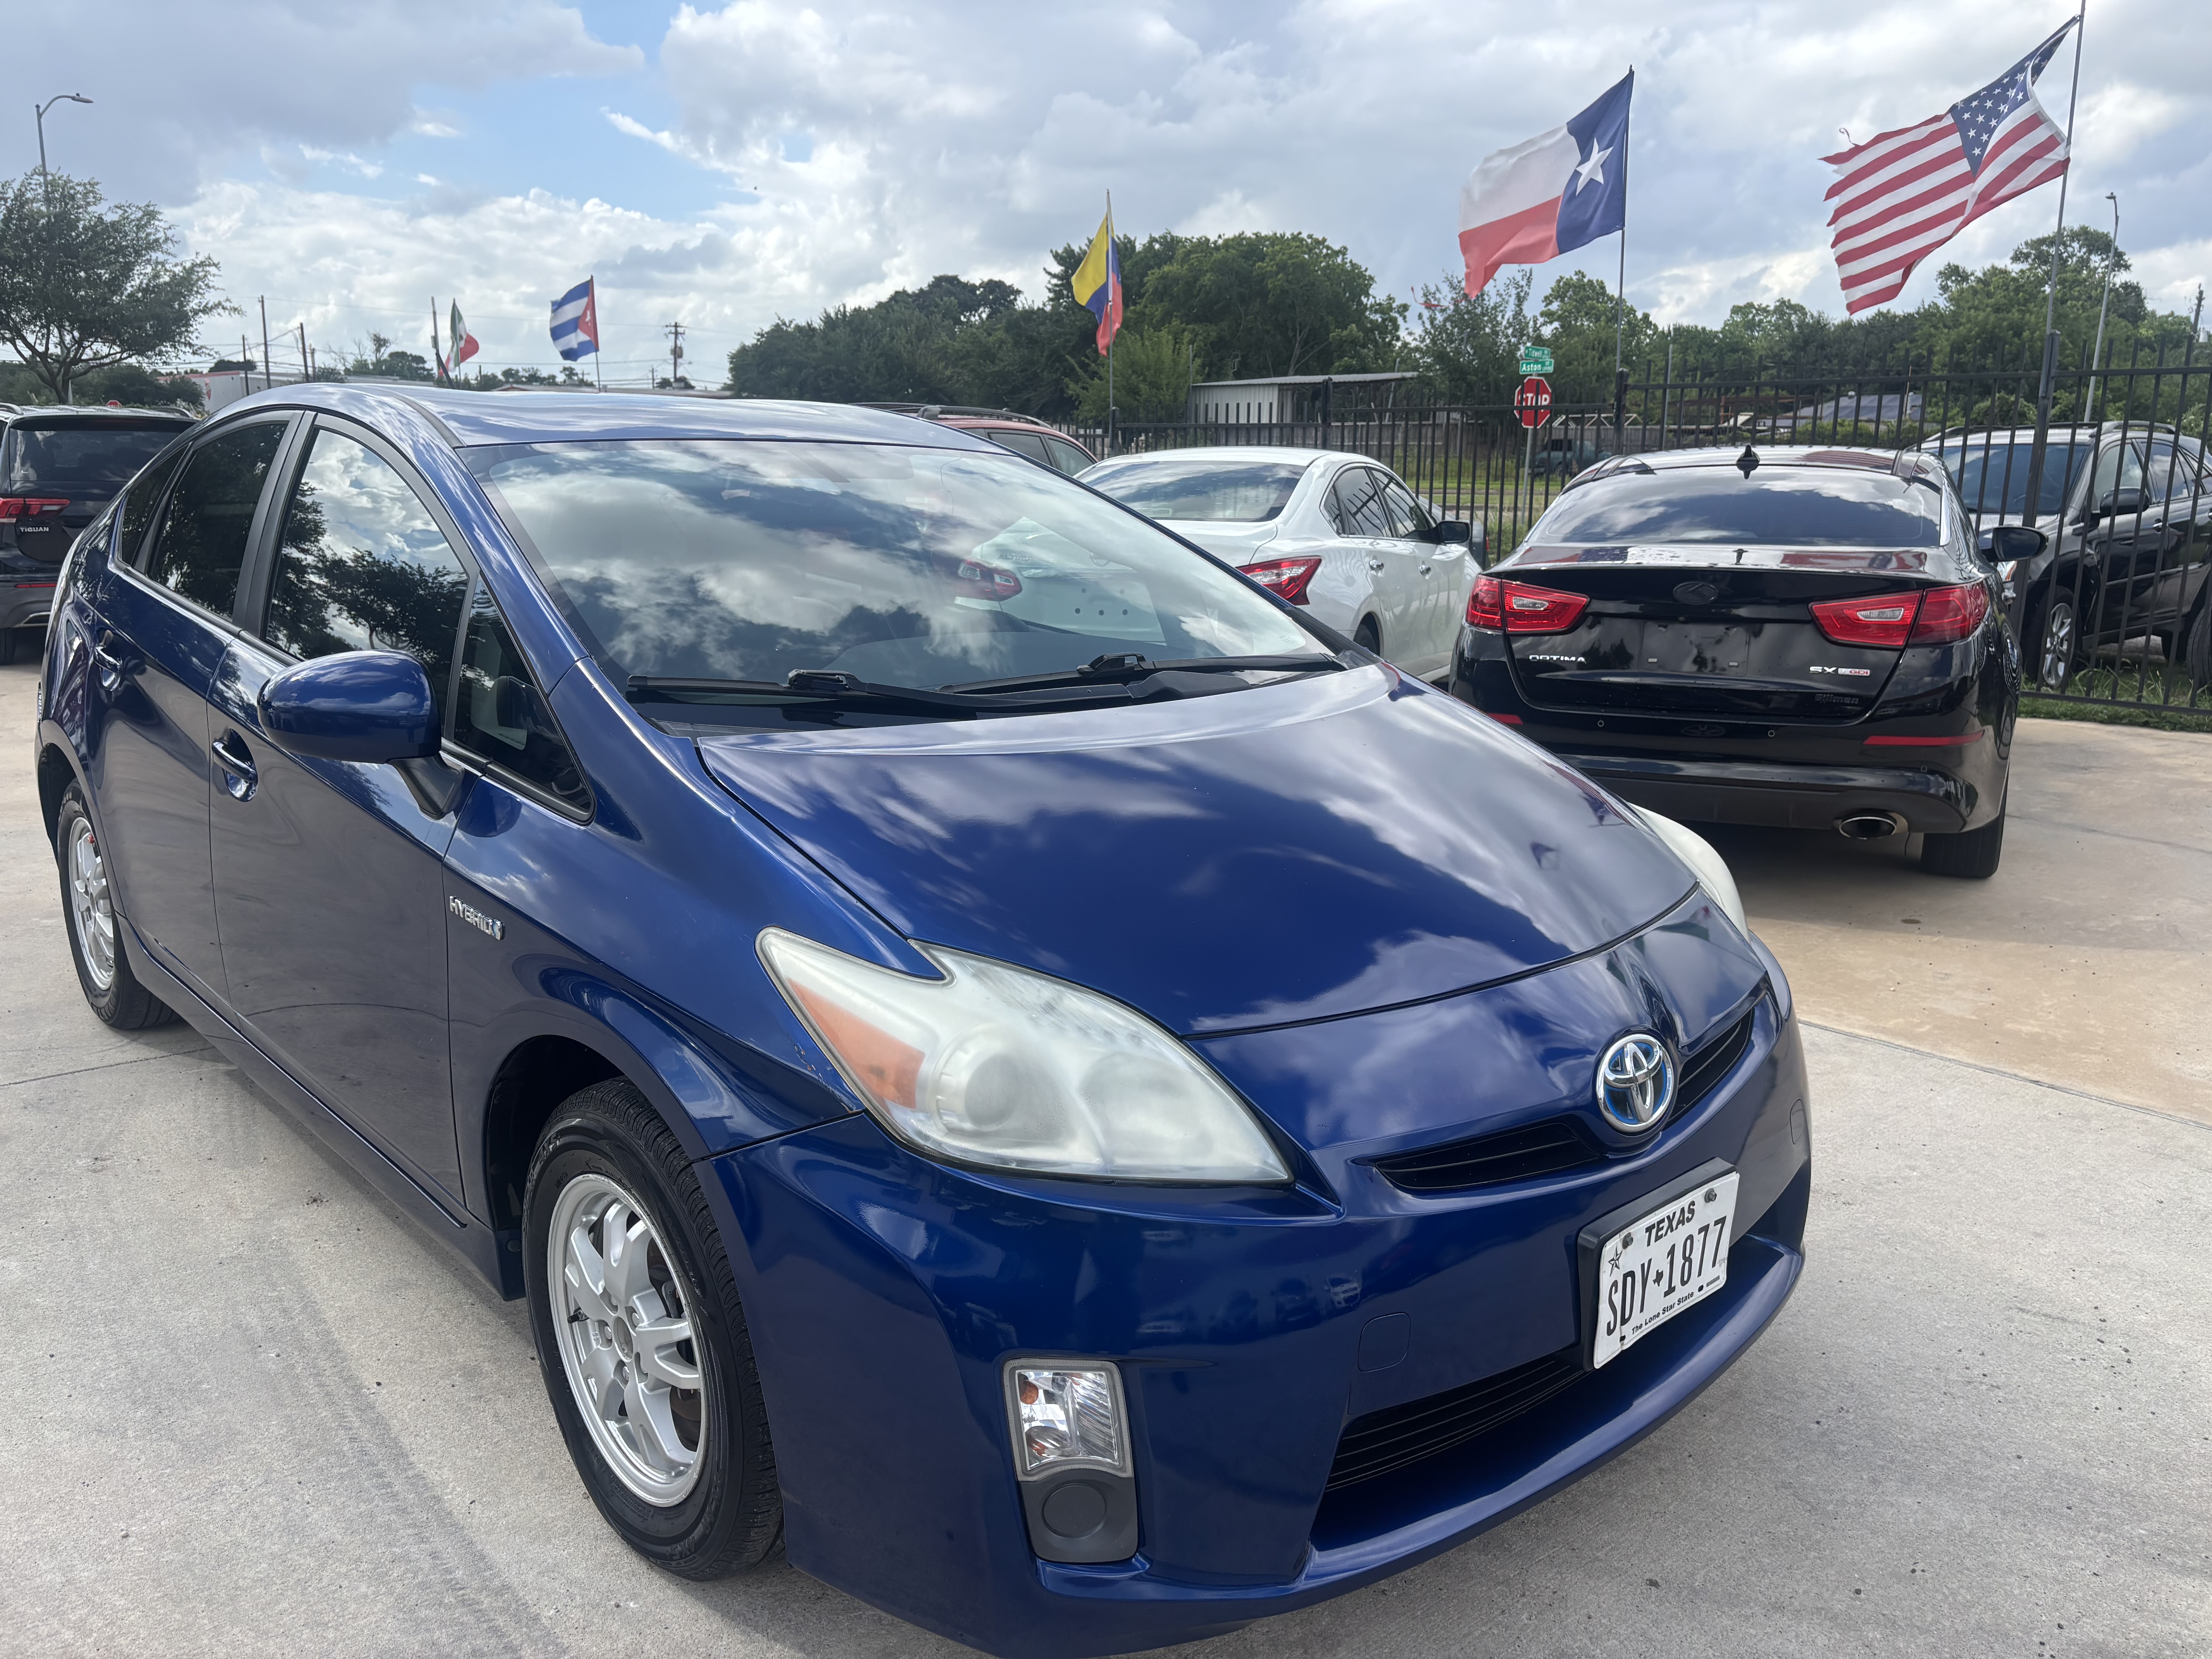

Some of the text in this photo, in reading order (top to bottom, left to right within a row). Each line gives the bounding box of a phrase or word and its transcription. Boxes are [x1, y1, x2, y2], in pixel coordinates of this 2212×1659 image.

[1521, 363, 1542, 372] Aston
[1529, 654, 1587, 664] OPTIMA
[1809, 666, 1837, 674] SX
[449, 895, 493, 935] HYBRID
[1645, 1200, 1695, 1247] TEXAS
[1606, 1215, 1727, 1336] SDY 1877
[1632, 1291, 1694, 1335] The Lone Star State
